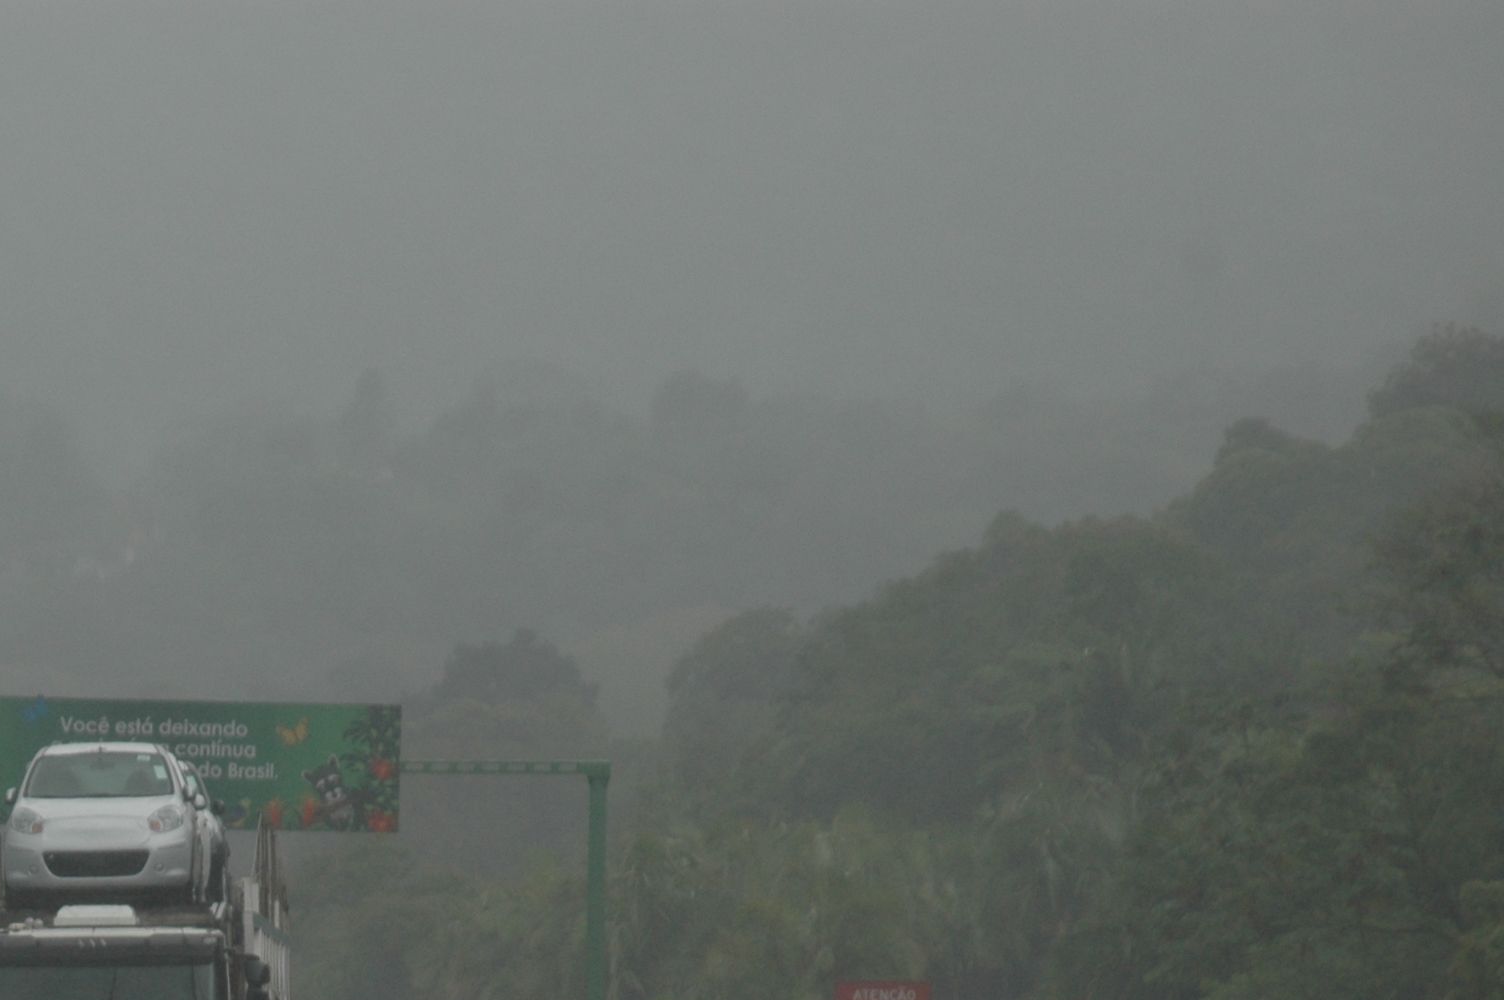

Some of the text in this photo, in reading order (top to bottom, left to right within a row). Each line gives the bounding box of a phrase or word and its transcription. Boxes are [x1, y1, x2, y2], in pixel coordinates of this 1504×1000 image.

[59, 716, 249, 738] Você está deixando
[174, 739, 257, 759] contínua
[227, 762, 279, 781] Brasil.
